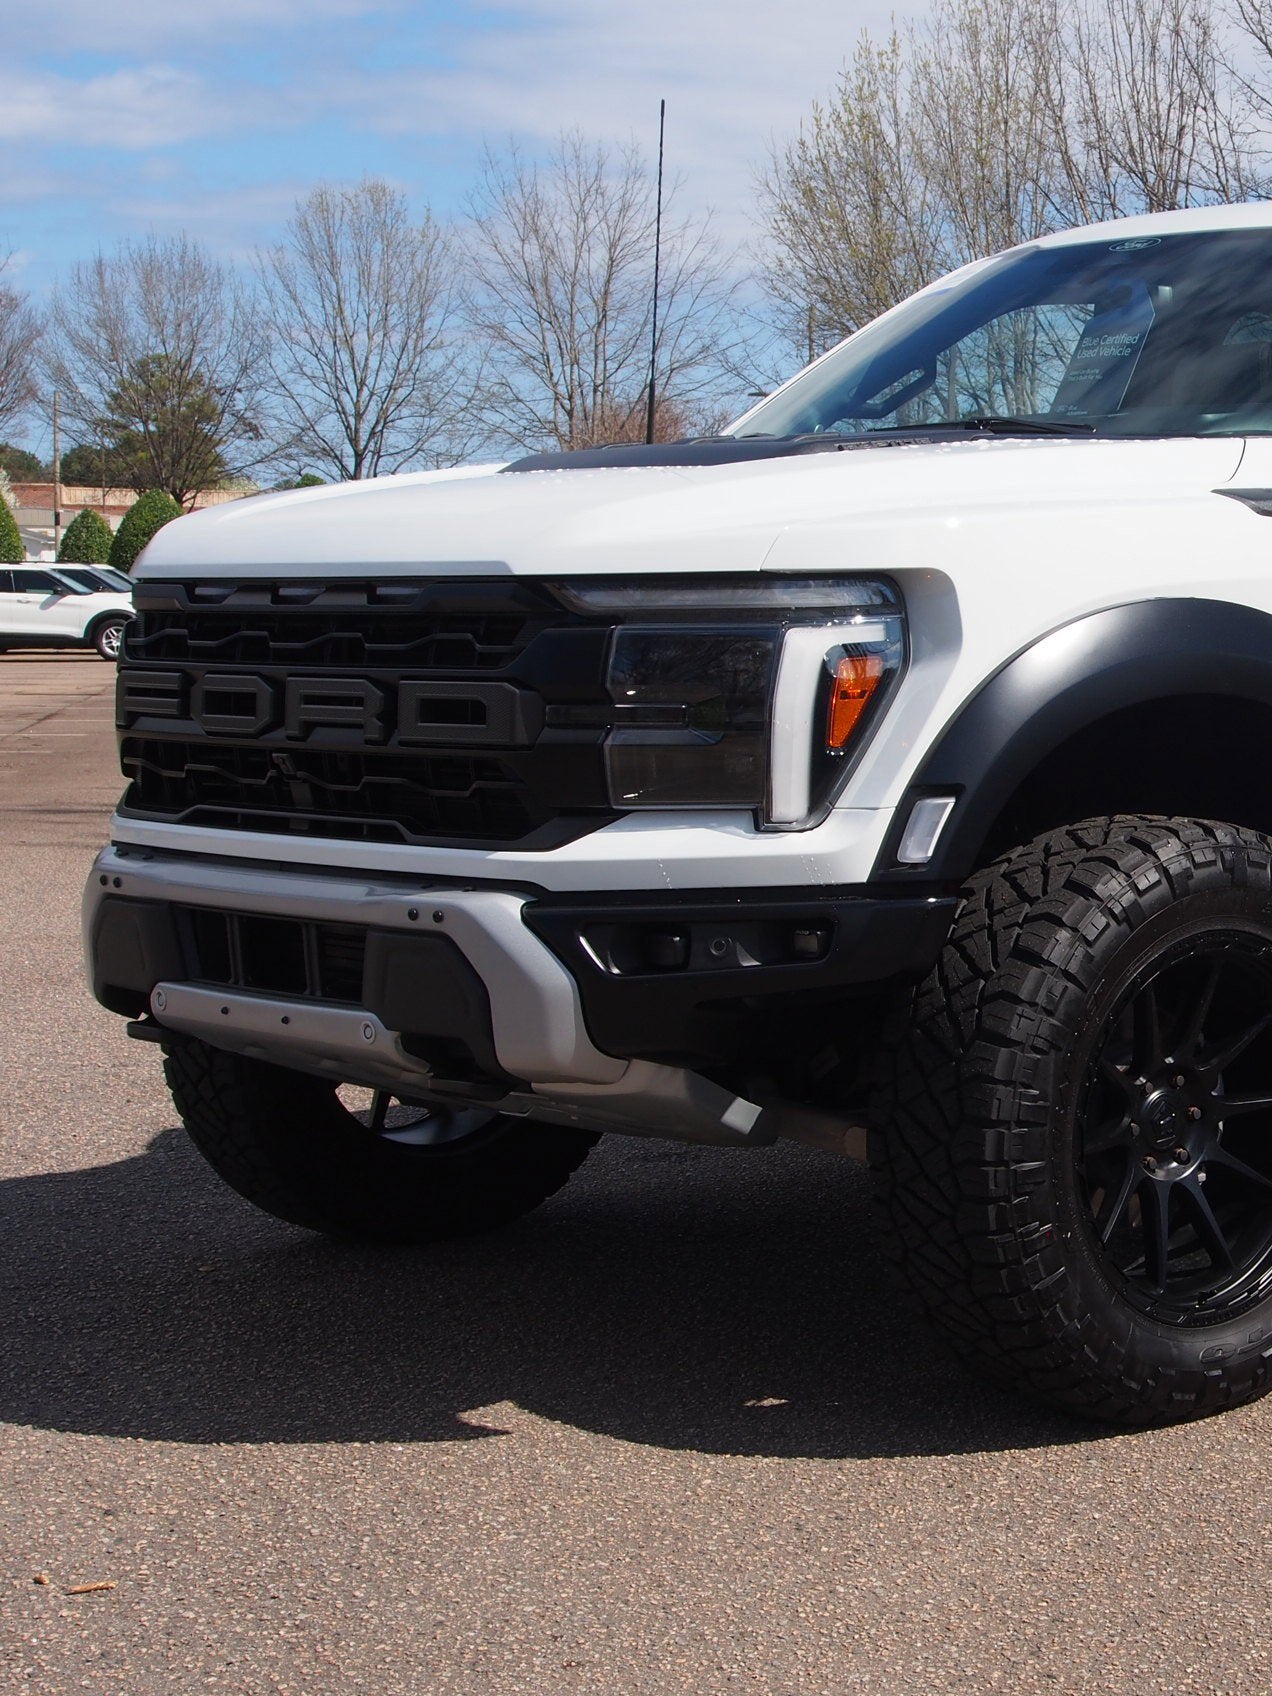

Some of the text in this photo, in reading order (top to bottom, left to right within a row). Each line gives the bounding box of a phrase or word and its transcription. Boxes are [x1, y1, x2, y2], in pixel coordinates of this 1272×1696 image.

[1100, 332, 1140, 345] Certified
[1077, 345, 1131, 359] Used Vehicle
[116, 670, 545, 750] FORD
